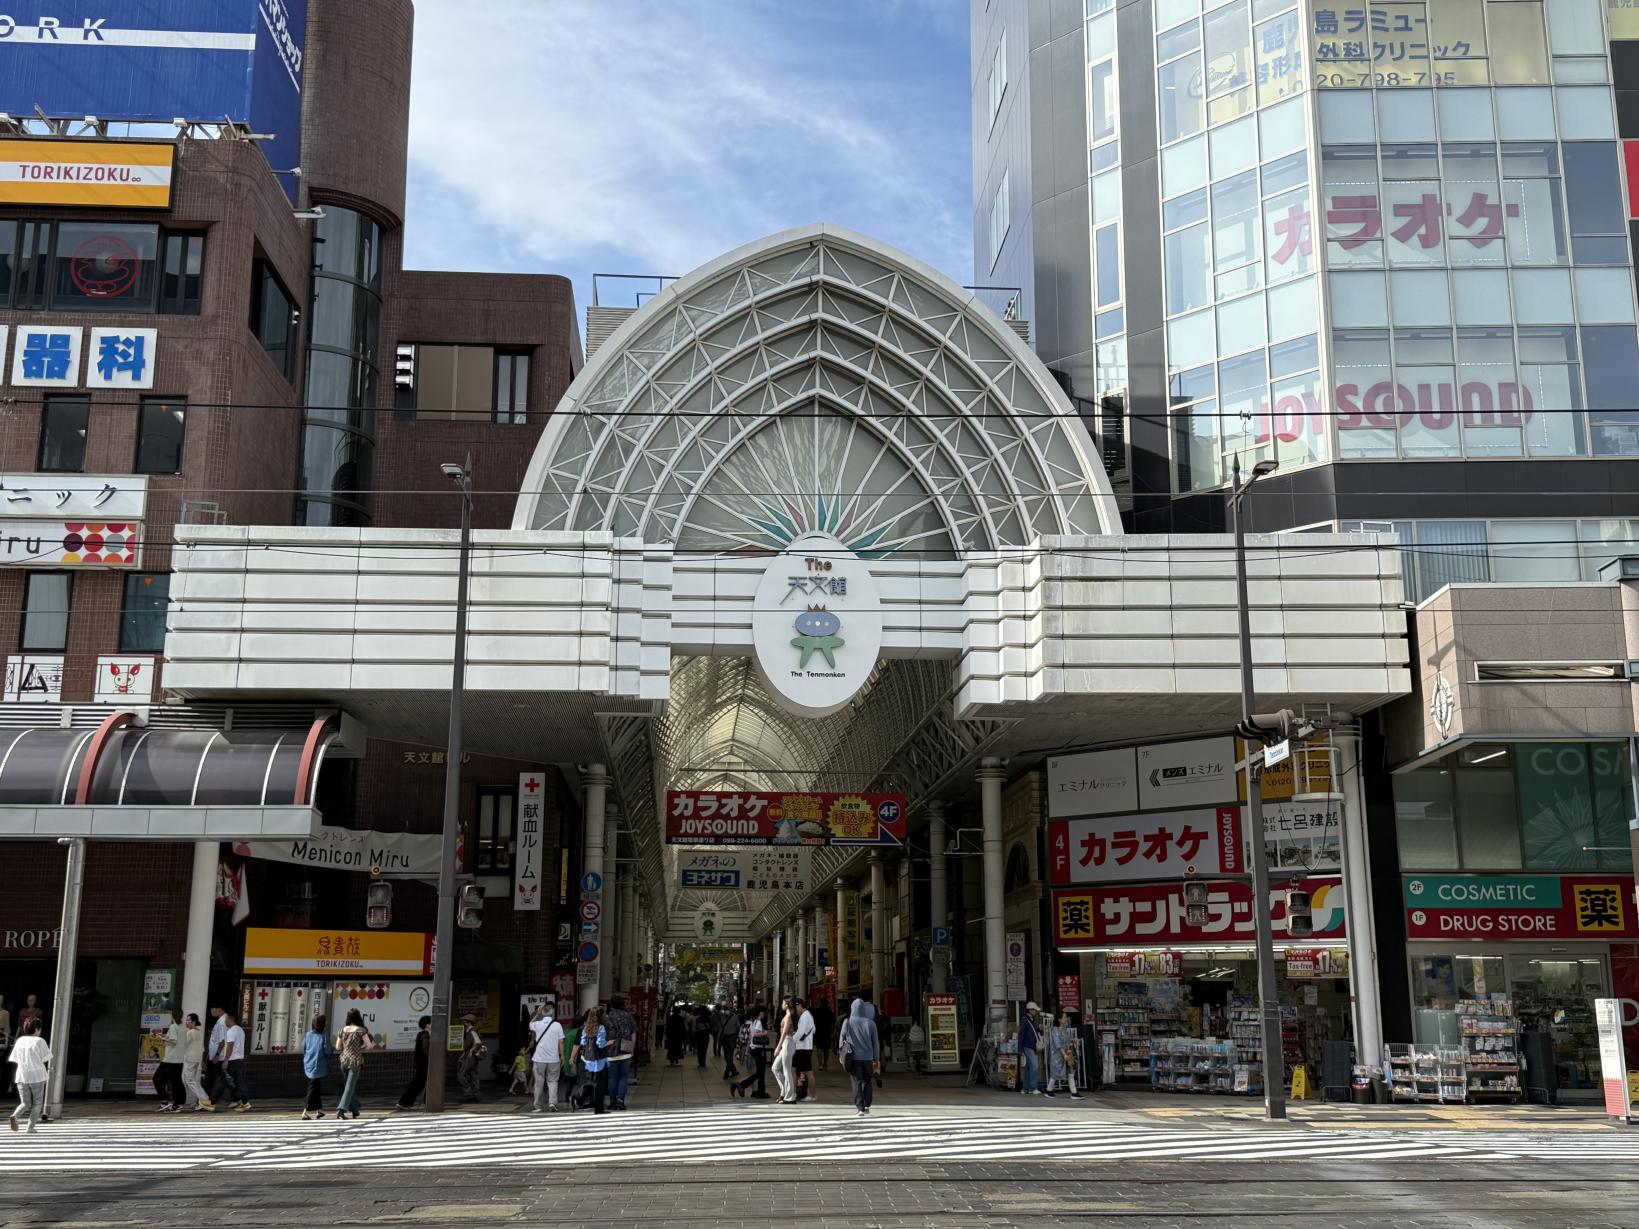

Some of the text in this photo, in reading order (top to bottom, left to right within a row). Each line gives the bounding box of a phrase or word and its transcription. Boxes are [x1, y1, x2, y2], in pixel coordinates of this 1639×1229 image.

[19, 165, 131, 182] TORIKIZOKU
[1272, 192, 1519, 264] カラオケ
[1256, 381, 1533, 444] JOYSOUND
[7, 484, 117, 508] ニック
[805, 558, 832, 571] The
[780, 576, 847, 605] 天文館
[403, 752, 471, 765] 天文館ル
[672, 794, 769, 817] カラオケ
[880, 805, 897, 817] 4F
[680, 819, 758, 835] JOYSOUND
[522, 803, 539, 879] 献血ルーム
[1079, 825, 1208, 866] カラオケ
[1222, 812, 1236, 869] JOYSOUND
[292, 841, 409, 868] Menicon Miru
[687, 855, 736, 868] メガネの
[686, 872, 736, 885] ヨネザワ
[746, 880, 804, 890] 鹿児島本店
[1412, 883, 1422, 891] 2F
[1438, 884, 1536, 900] COSMETIC
[1579, 888, 1620, 928] 薬
[1061, 900, 1090, 935] 薬
[1414, 914, 1424, 922] 1F
[1440, 915, 1556, 931] DRUG STORE
[937, 928, 947, 944] P
[317, 959, 360, 968] TORIKIZOKU
[255, 1002, 267, 1050] 献血ルーム
